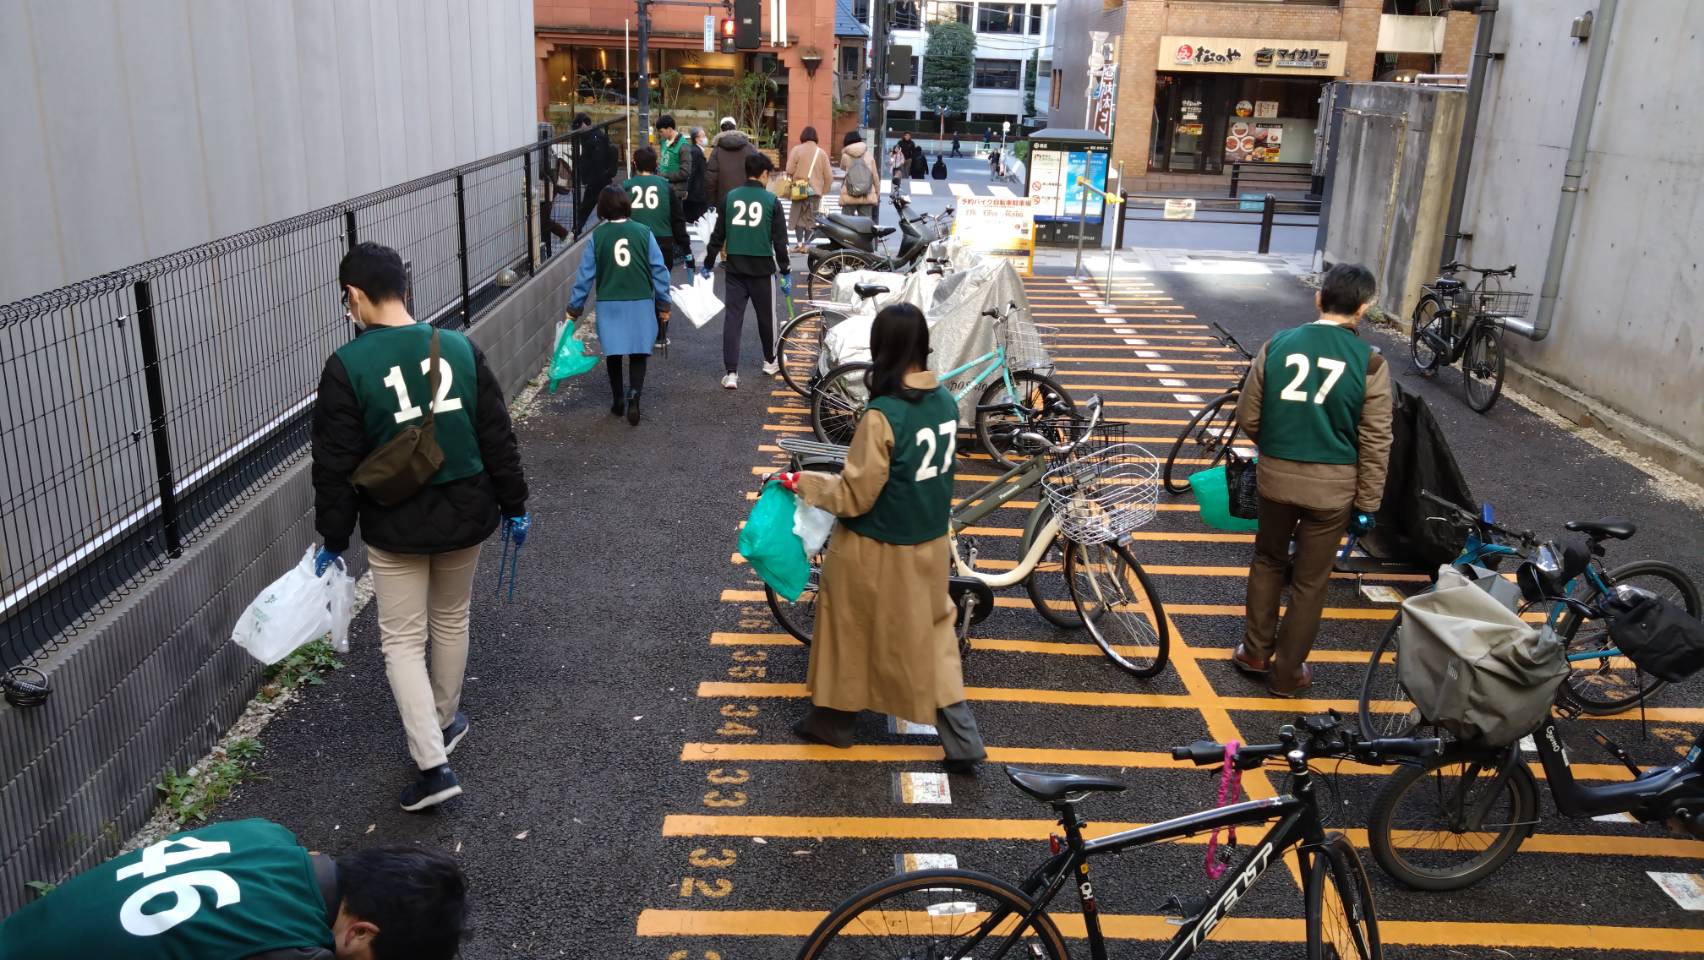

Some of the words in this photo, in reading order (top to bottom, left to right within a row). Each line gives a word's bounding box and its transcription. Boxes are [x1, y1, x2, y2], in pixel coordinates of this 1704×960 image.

[1276, 48, 1330, 62] マイカリー
[631, 186, 659, 209] 26
[732, 200, 763, 227] 29
[614, 238, 631, 267] 6
[384, 357, 463, 424] 12
[1281, 353, 1347, 405] 27
[915, 419, 957, 482] 27
[728, 650, 769, 679] 35
[715, 703, 760, 737] 34
[703, 768, 751, 809] 33
[116, 836, 241, 936] 46
[679, 847, 737, 899] 32
[1191, 842, 1274, 950] FELT
